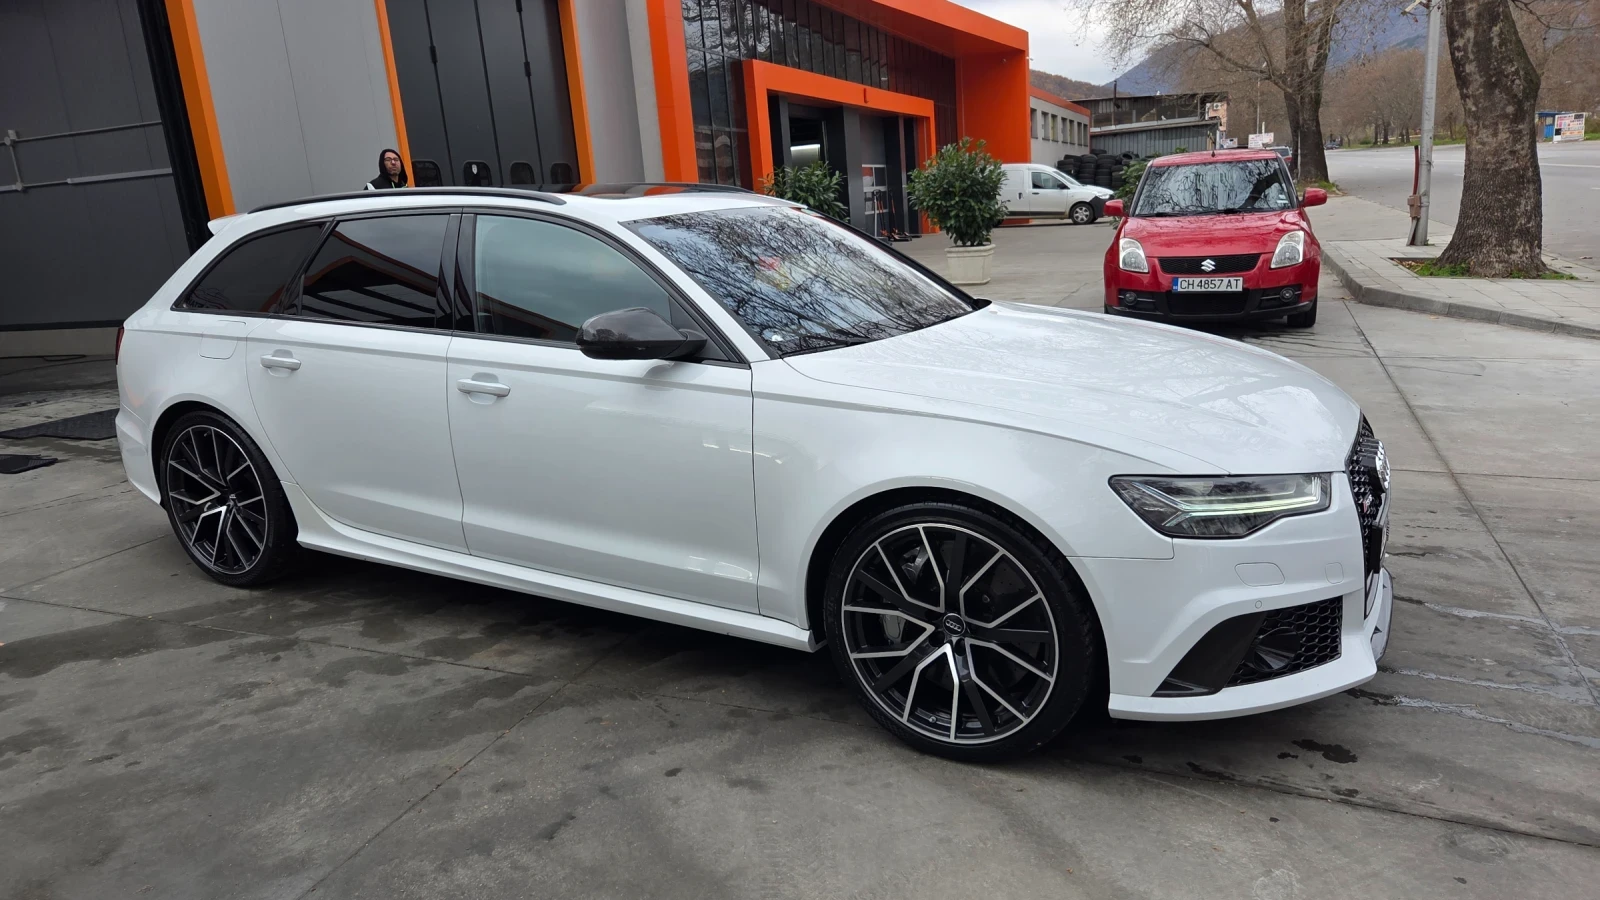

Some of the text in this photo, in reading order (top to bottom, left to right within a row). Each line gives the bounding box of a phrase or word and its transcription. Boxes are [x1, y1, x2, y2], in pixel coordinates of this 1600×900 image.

[1180, 279, 1194, 289] CH
[1196, 279, 1224, 289] 4857
[1226, 279, 1240, 289] AT
